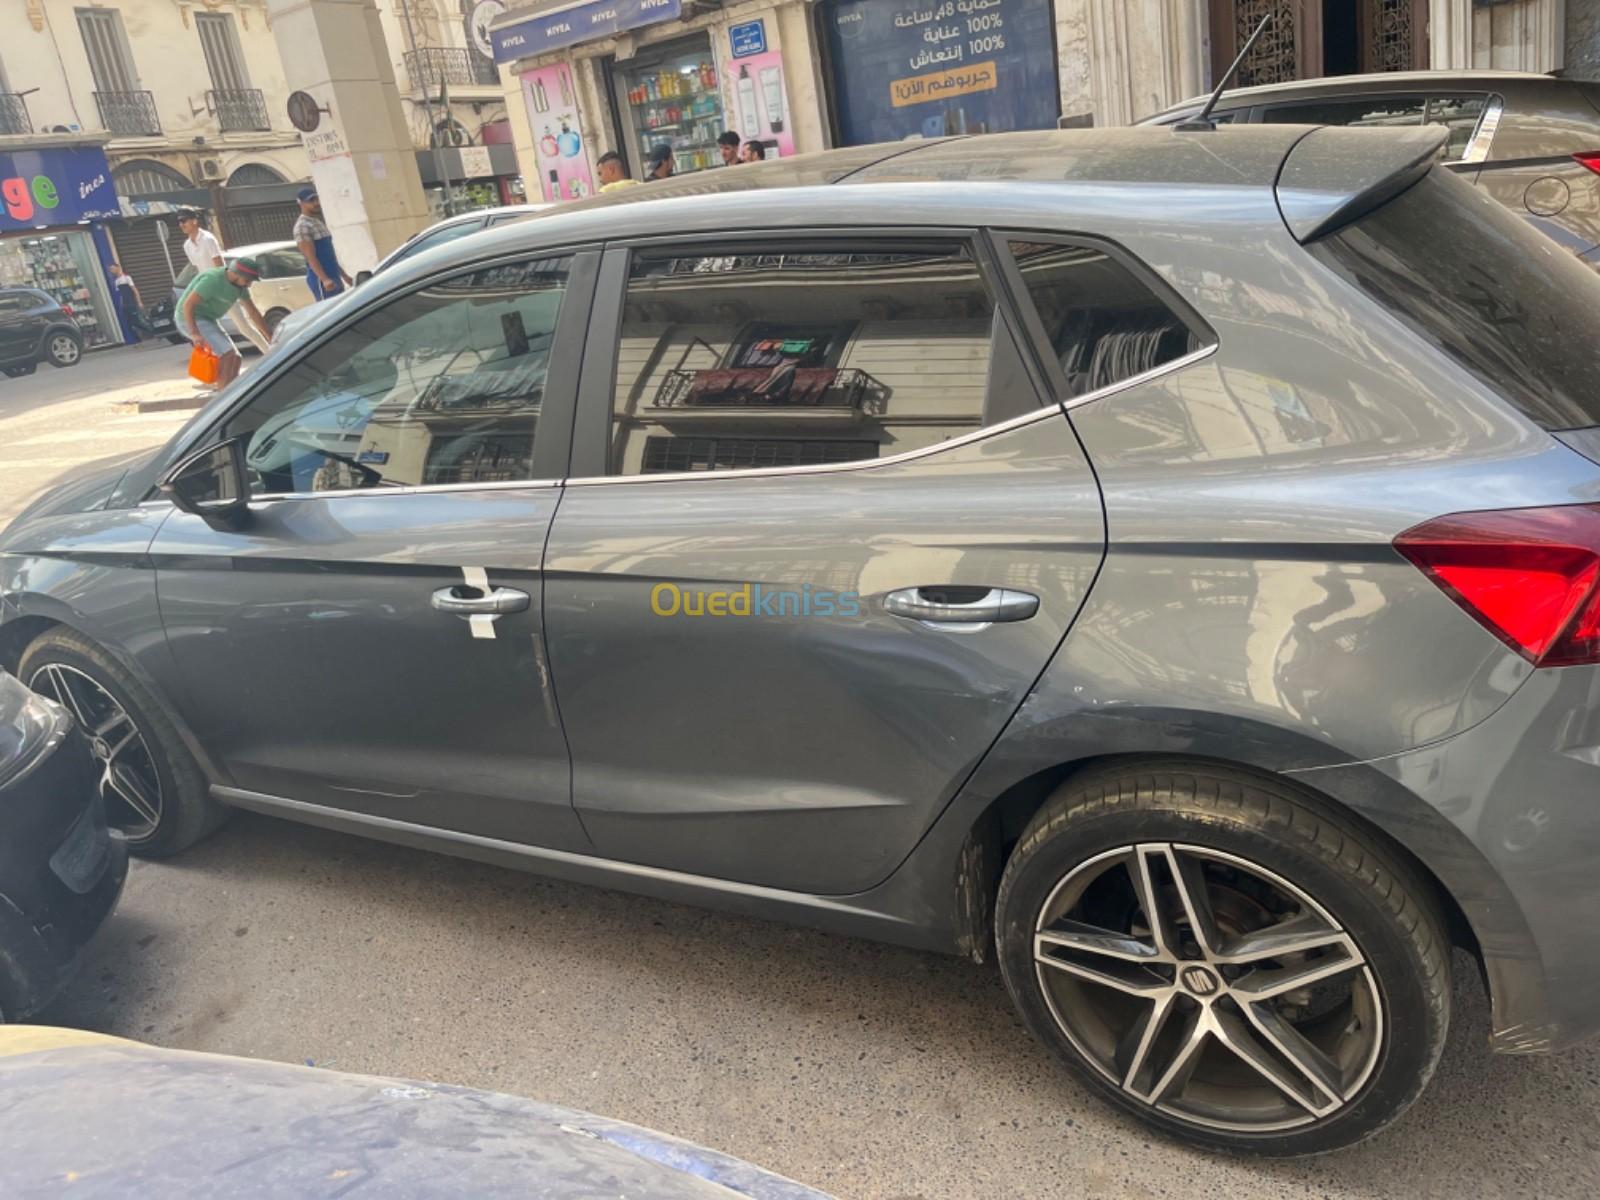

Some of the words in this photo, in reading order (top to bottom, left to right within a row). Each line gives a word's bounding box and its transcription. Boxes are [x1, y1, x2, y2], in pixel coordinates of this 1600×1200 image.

[591, 9, 617, 24] NIVEA
[894, 10, 933, 27] ساعة
[966, 12, 1003, 34] 100%
[546, 23, 571, 37] NIVEA
[923, 25, 960, 43] عناية
[501, 35, 526, 48] NIVEA
[968, 34, 1006, 55] 100%
[909, 45, 963, 69] إنتعاش
[927, 71, 991, 96] جربوهم
[0, 175, 59, 221] ge
